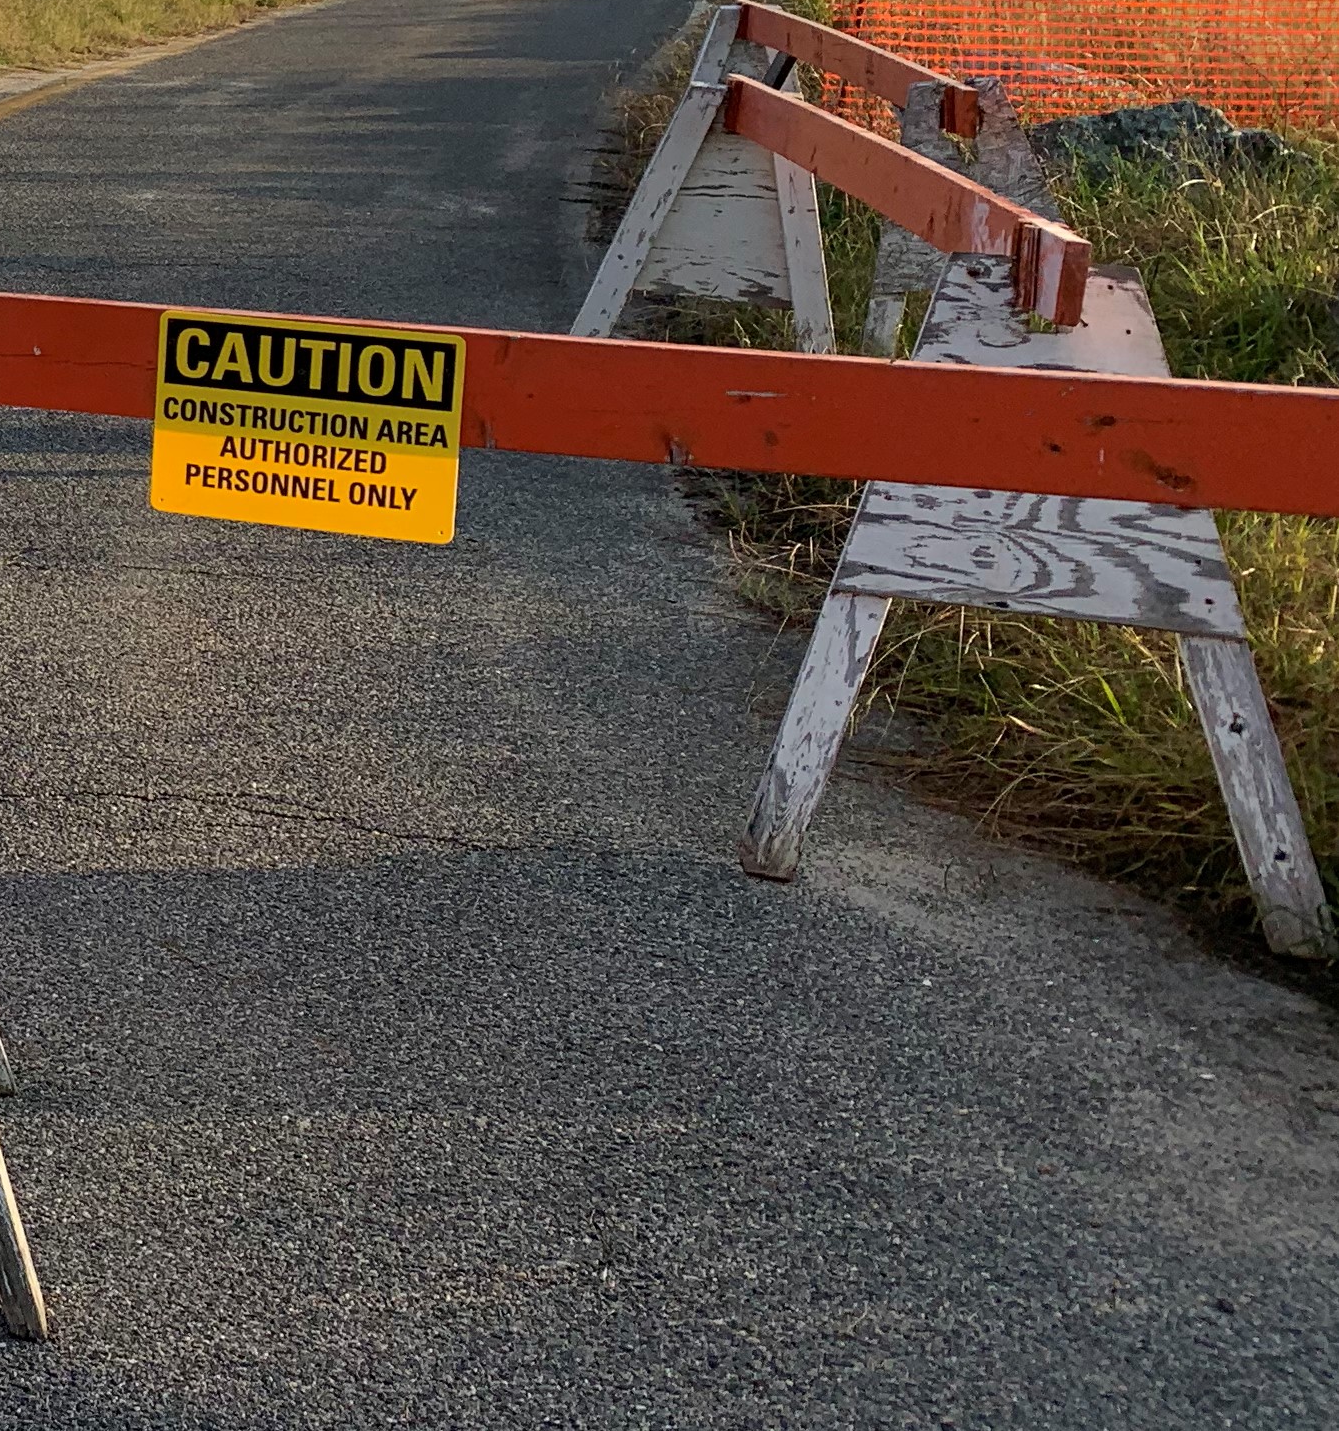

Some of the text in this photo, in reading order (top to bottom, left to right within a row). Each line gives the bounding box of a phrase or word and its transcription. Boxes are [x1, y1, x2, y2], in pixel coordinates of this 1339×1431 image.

[176, 327, 445, 402] CAUTION
[163, 396, 448, 448] CONSTRUCTION AREA
[220, 436, 387, 474] AUTHORIZED
[185, 463, 418, 510] PERSONNEL ONLY
